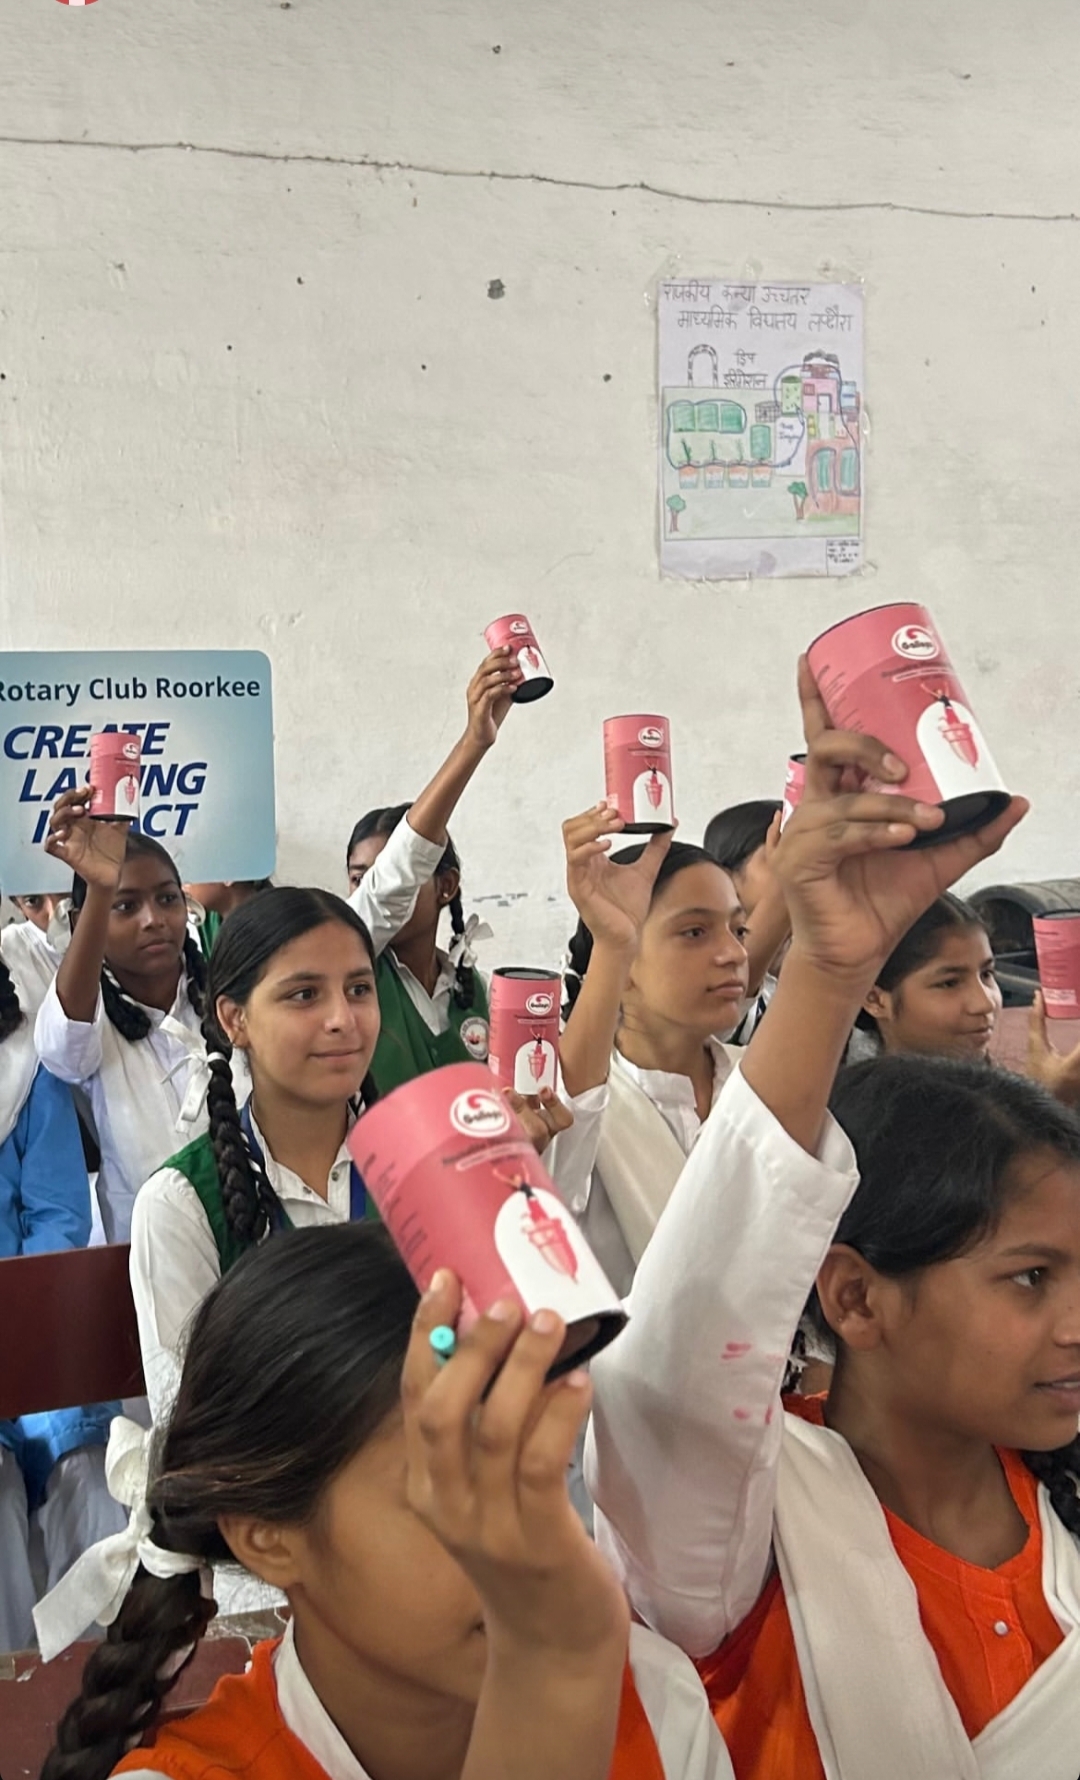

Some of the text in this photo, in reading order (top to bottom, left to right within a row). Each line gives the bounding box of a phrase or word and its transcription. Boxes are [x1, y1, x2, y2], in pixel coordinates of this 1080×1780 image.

[663, 280, 712, 302] राजकीय
[723, 285, 756, 302] कन्या
[677, 304, 739, 330] माध्यमिक
[89, 677, 147, 700] Club
[156, 675, 261, 698] Roorkee
